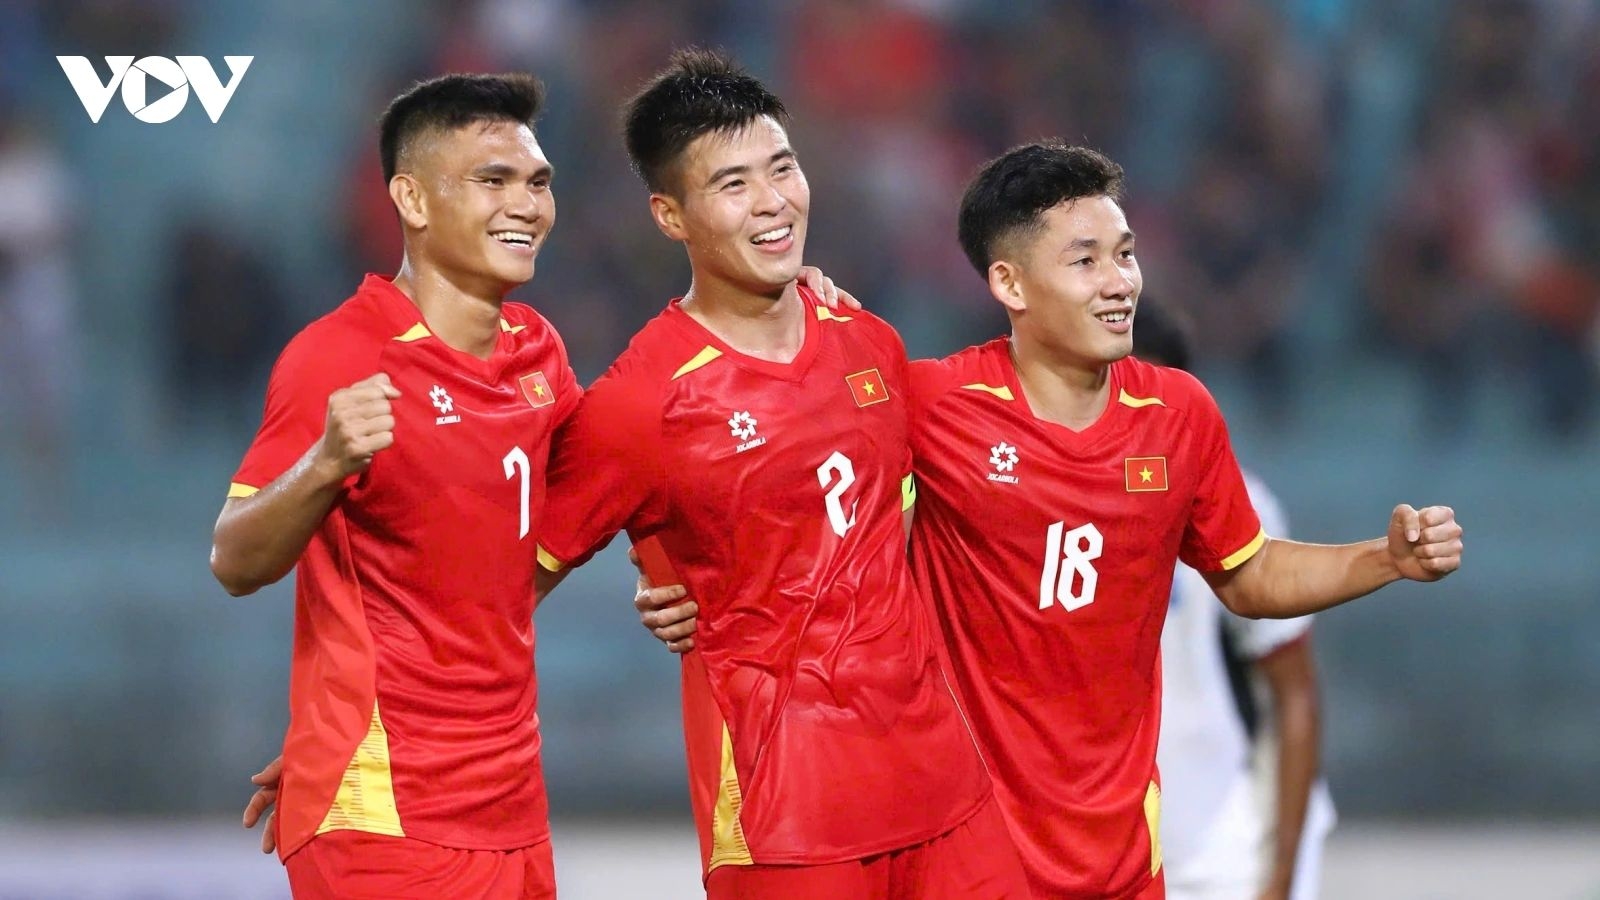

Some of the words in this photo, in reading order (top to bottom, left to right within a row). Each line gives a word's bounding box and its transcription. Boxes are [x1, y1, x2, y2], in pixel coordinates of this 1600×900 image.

[502, 446, 531, 540] 7
[816, 450, 860, 538] 2
[1039, 520, 1104, 613] 18
